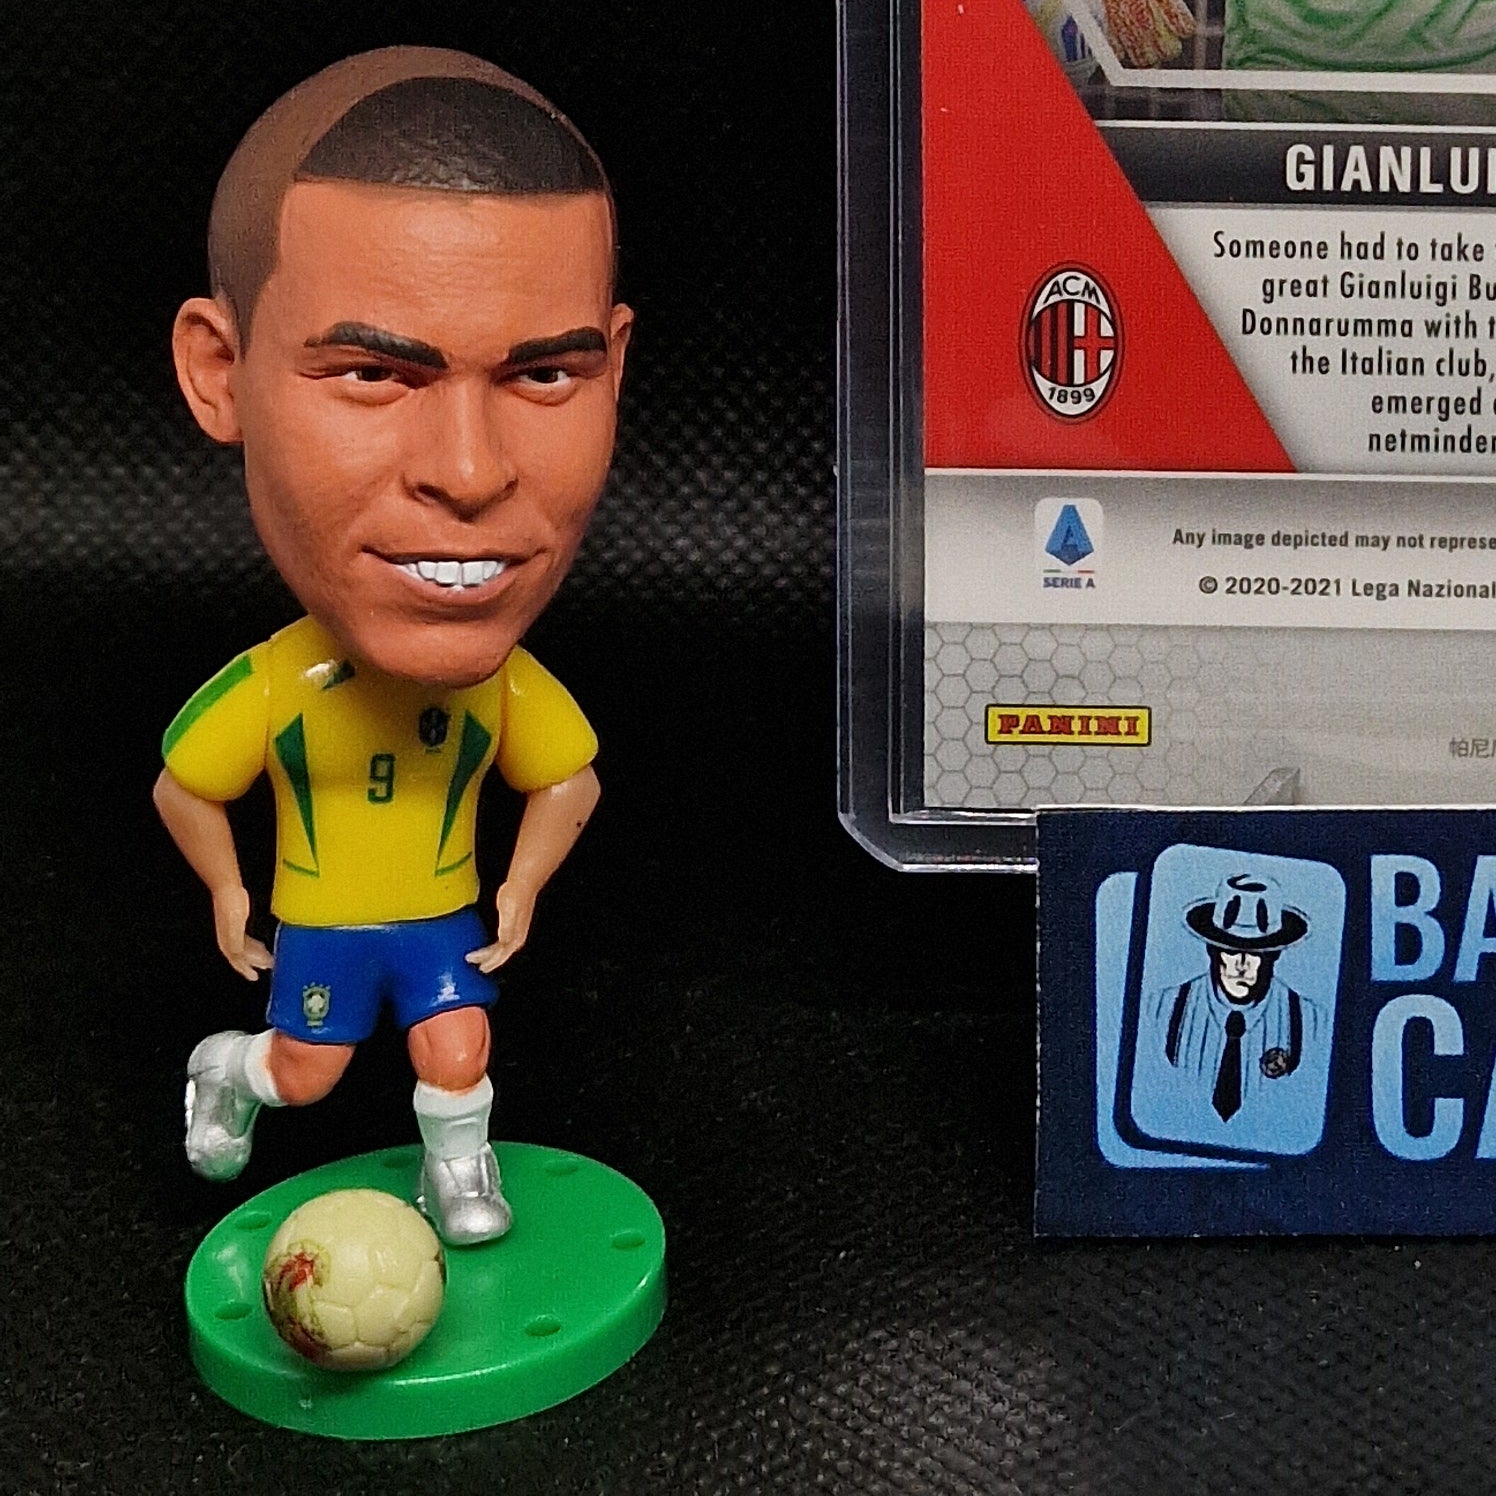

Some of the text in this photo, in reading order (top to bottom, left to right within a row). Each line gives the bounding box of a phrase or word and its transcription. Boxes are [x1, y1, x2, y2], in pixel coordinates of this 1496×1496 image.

[1213, 228, 1329, 259] Someone
[1340, 230, 1386, 260] had
[1396, 235, 1419, 260] to
[1429, 232, 1485, 262] take
[1043, 275, 1102, 305] ACM
[1261, 272, 1330, 304] great
[1340, 270, 1457, 306] Gianluigi
[1241, 306, 1413, 337] Donnarumma
[1424, 310, 1478, 338] with
[1290, 344, 1330, 374] the
[1341, 345, 1425, 376] Italian
[1435, 347, 1495, 382] club,
[1047, 387, 1097, 405] 1899
[1371, 387, 1482, 422] emerged
[1172, 527, 1206, 548] Any
[1211, 527, 1266, 549] image
[1271, 529, 1349, 549] depicted
[1355, 534, 1391, 551] may
[1396, 533, 1425, 548] not
[1042, 576, 1096, 589] SERIE A
[1224, 576, 1341, 596] 2020-2021
[1351, 578, 1400, 601] Lega
[997, 713, 1140, 736] PANINI
[367, 753, 397, 803] 9
